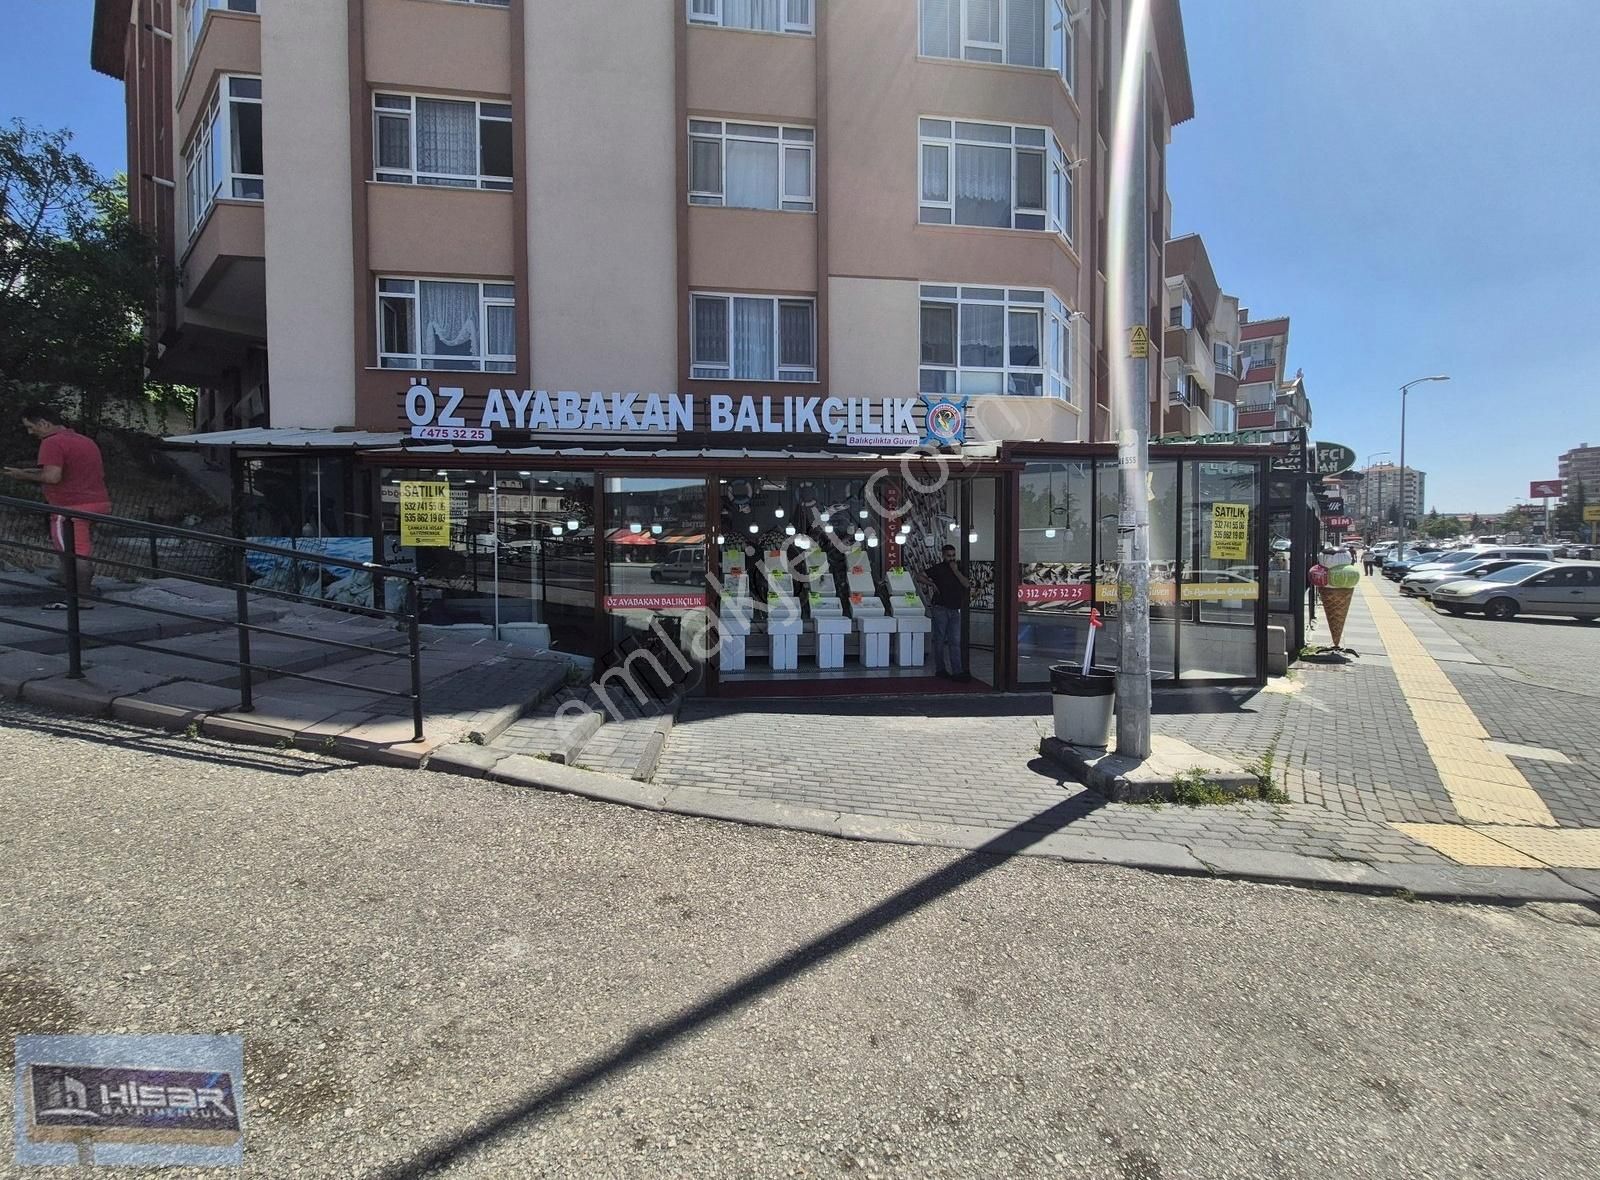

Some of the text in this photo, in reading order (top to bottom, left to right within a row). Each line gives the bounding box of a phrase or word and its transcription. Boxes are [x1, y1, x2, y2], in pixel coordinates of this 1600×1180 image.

[405, 377, 919, 439] ÖZ AYABAKAN BALIKÇILIK
[427, 429, 485, 439] 475 32 25
[849, 436, 918, 445] Balıkçılıkta Güven
[404, 485, 446, 497] SATILIK
[1215, 506, 1246, 518] SATILIK
[1017, 588, 1082, 599] 0 312 475 32 25
[607, 597, 702, 607] ÖZ AYABAKAN BALIKÇILIK
